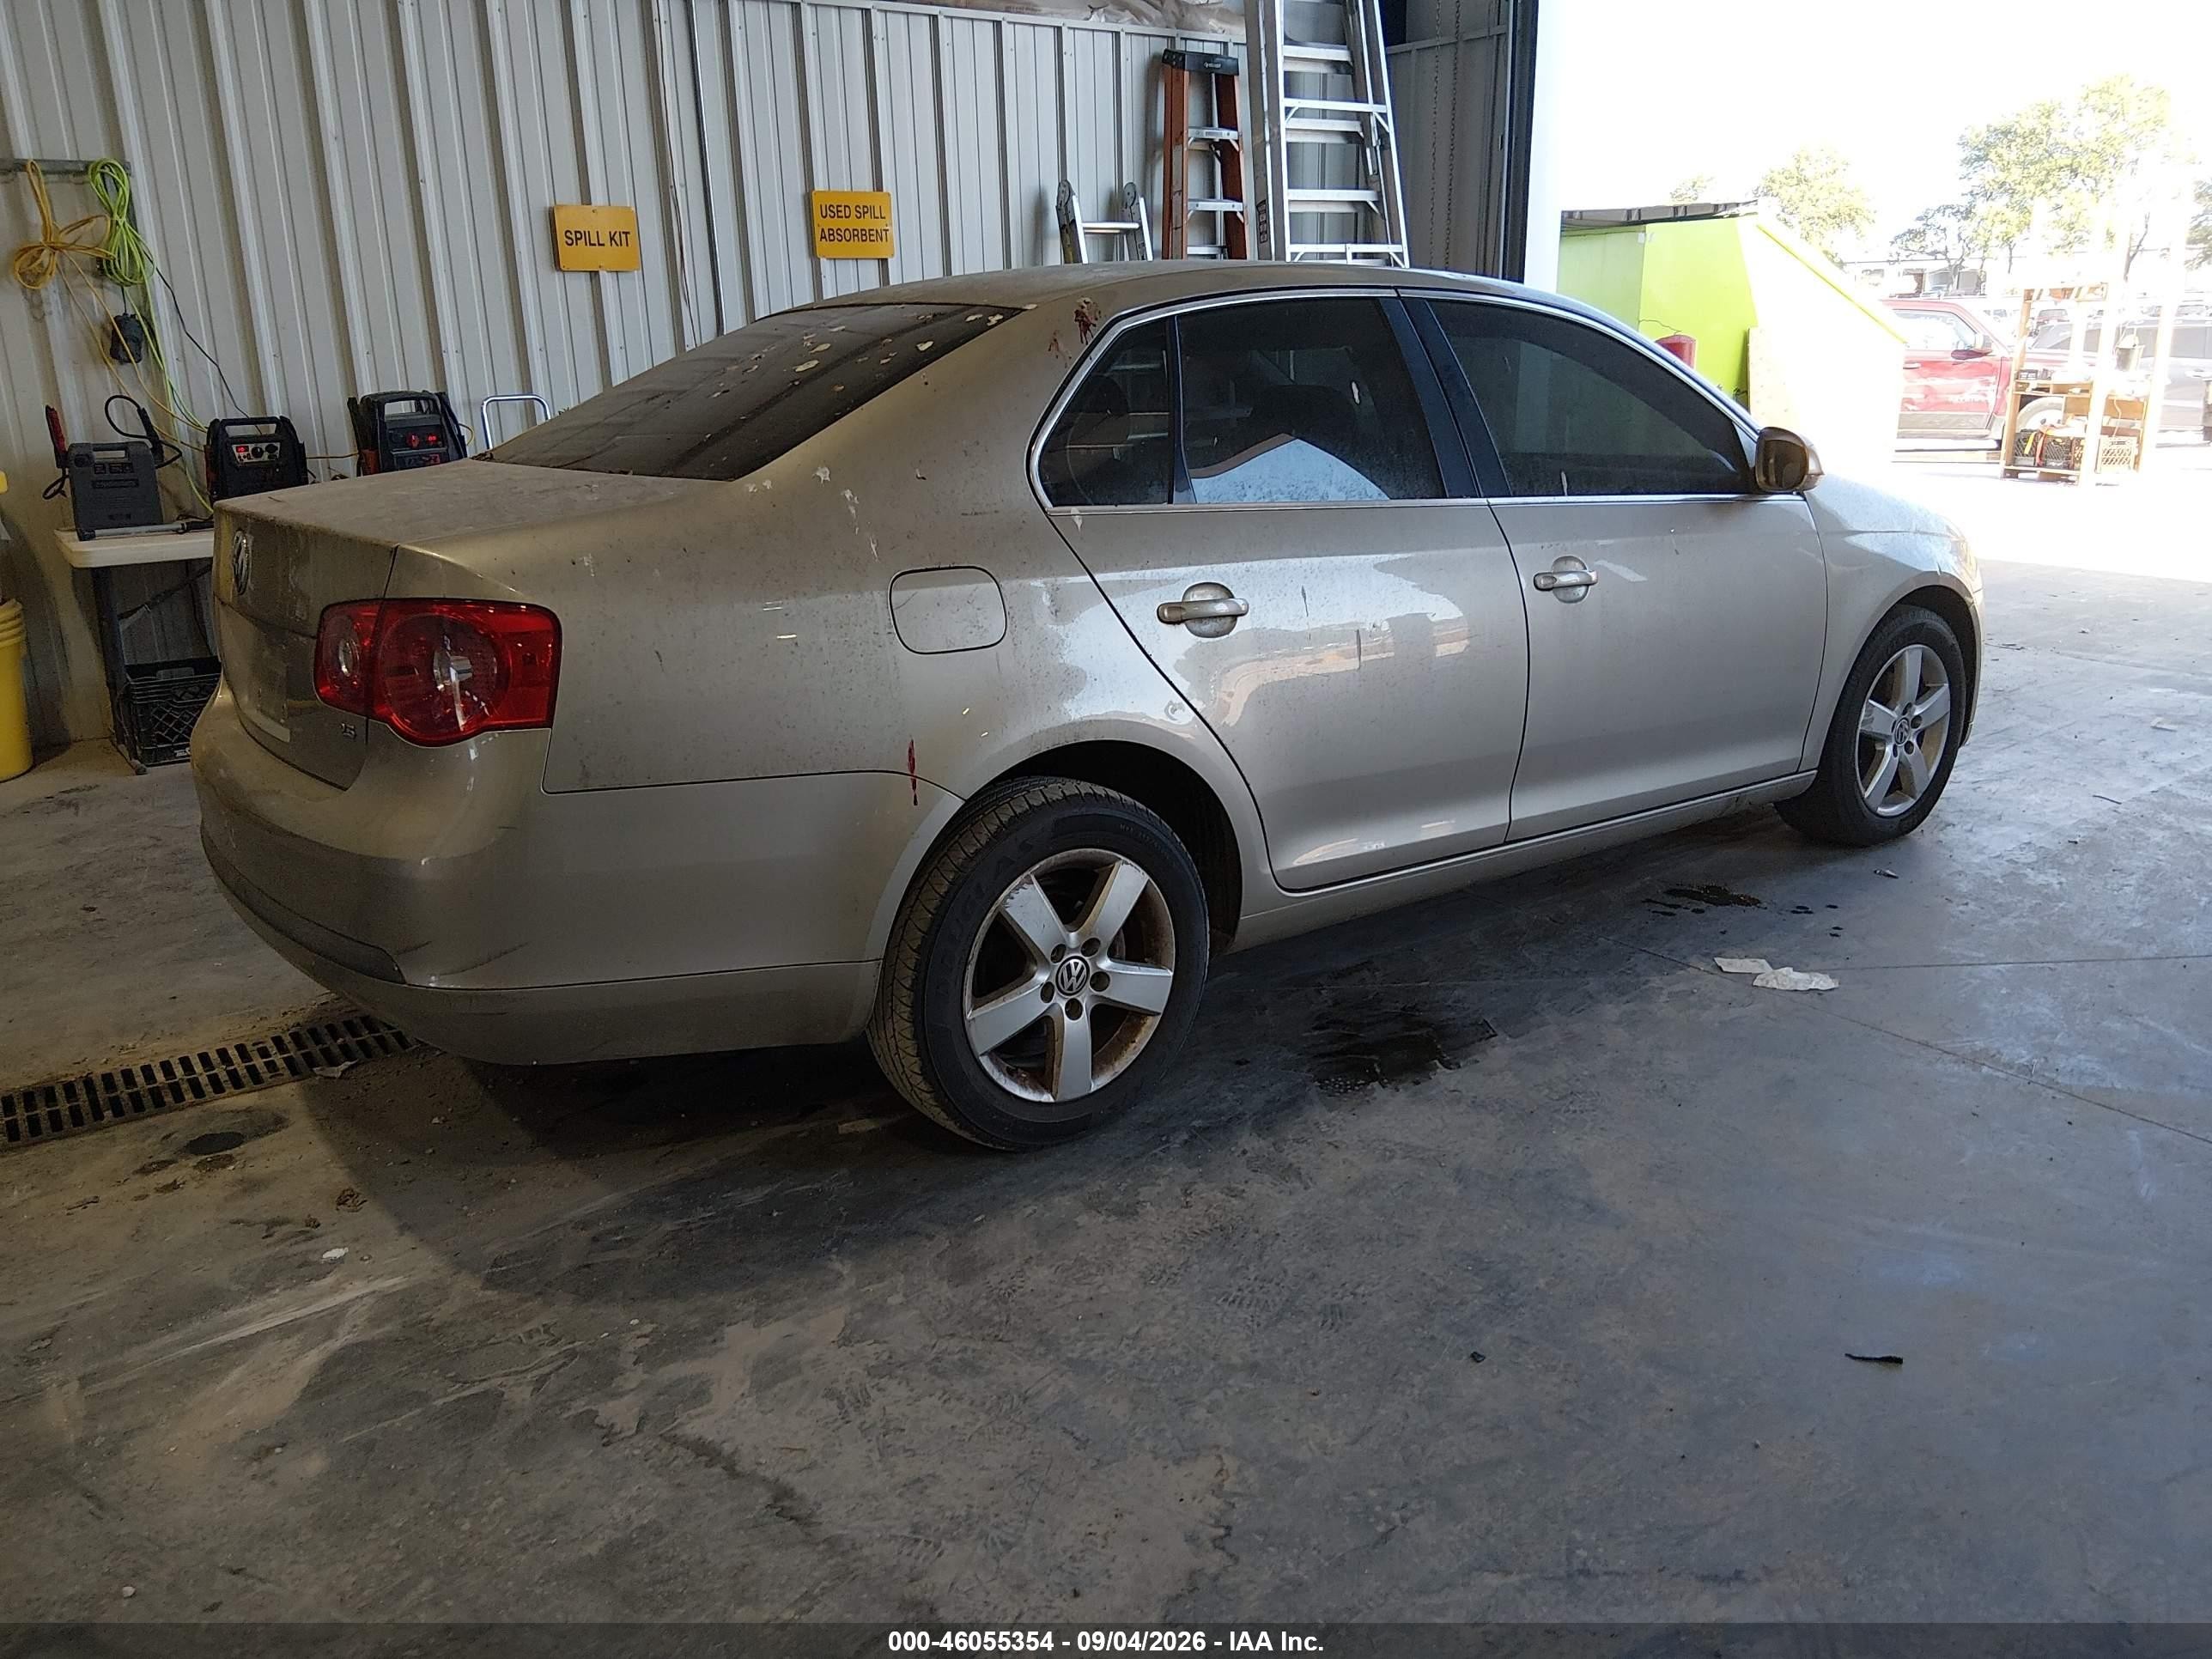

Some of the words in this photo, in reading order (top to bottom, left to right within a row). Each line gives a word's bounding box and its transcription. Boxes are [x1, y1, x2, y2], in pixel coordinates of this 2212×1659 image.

[819, 204, 852, 219] USED
[854, 204, 886, 220] SPILL
[564, 229, 605, 247] SPILL
[608, 229, 631, 247] KIT
[819, 227, 890, 243] ABSORBENT
